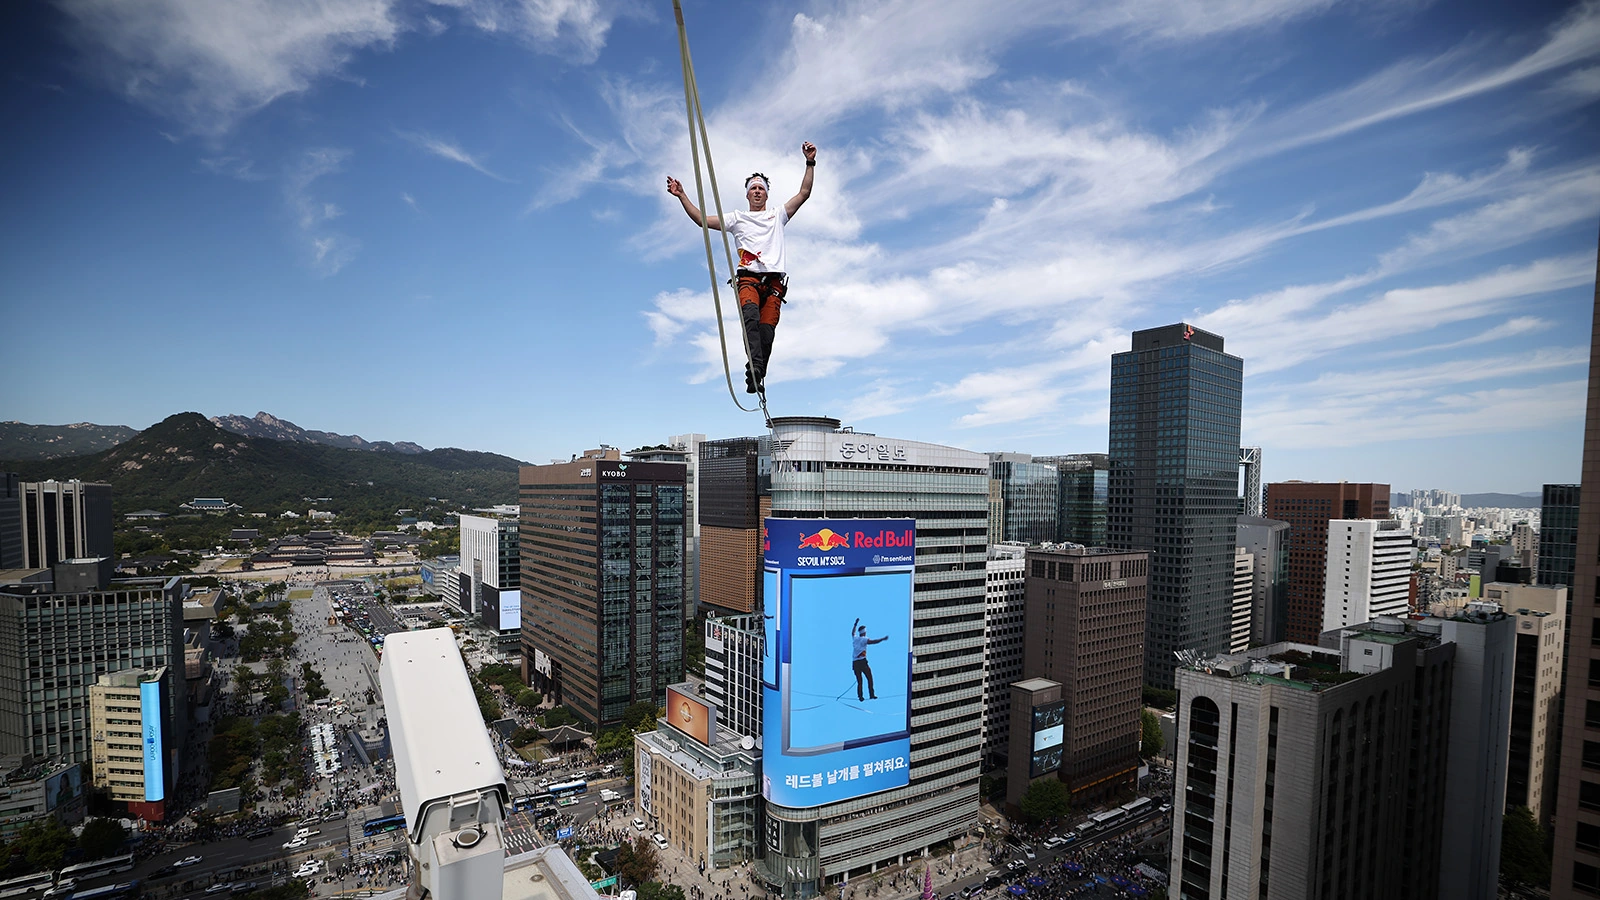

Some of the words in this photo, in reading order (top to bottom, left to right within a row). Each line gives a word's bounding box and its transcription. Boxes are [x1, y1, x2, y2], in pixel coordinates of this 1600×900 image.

[839, 441, 907, 461] 동아일보
[602, 470, 626, 478] KYOBO
[854, 530, 884, 548] Red
[885, 529, 913, 547] Bull
[889, 554, 912, 562] sentient
[785, 772, 823, 789] 레드불
[827, 765, 860, 785] 날개를
[863, 756, 908, 777] 펼쳐줘요.
